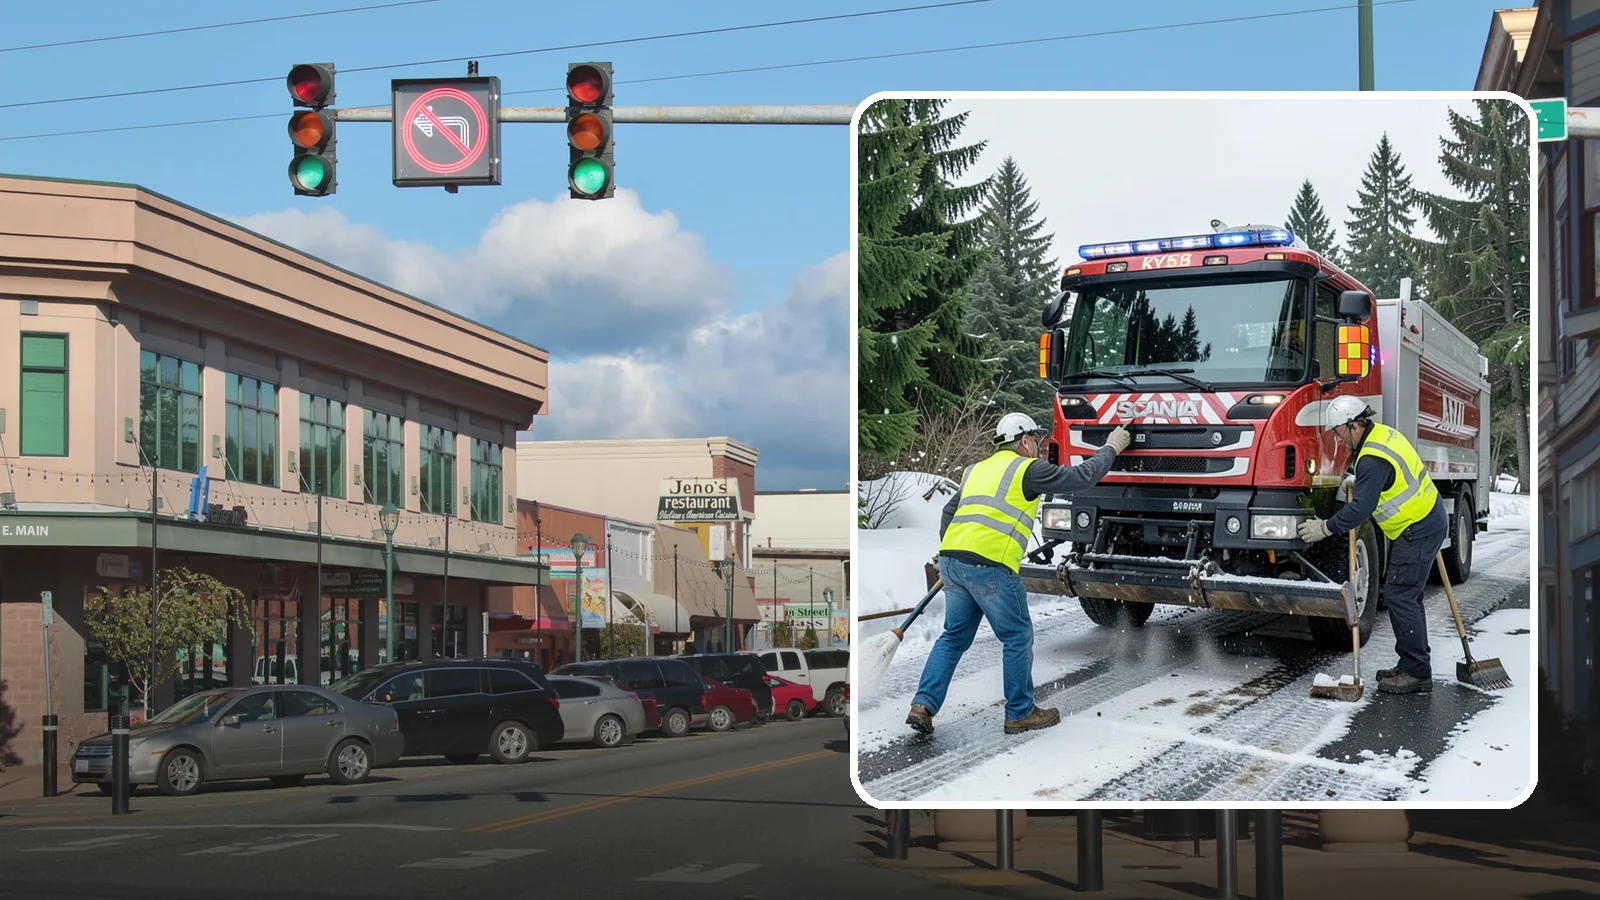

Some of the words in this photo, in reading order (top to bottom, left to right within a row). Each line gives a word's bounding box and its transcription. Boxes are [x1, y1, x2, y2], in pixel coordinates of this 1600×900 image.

[1115, 399, 1200, 419] SCANIA
[669, 480, 728, 494] Jeno's
[665, 496, 731, 509] restaurant
[658, 510, 681, 519] Italian
[686, 509, 714, 519] American
[714, 509, 737, 519] Cuisine
[2, 525, 13, 536] E.
[15, 525, 49, 536] MAIN
[797, 607, 828, 617] Street
